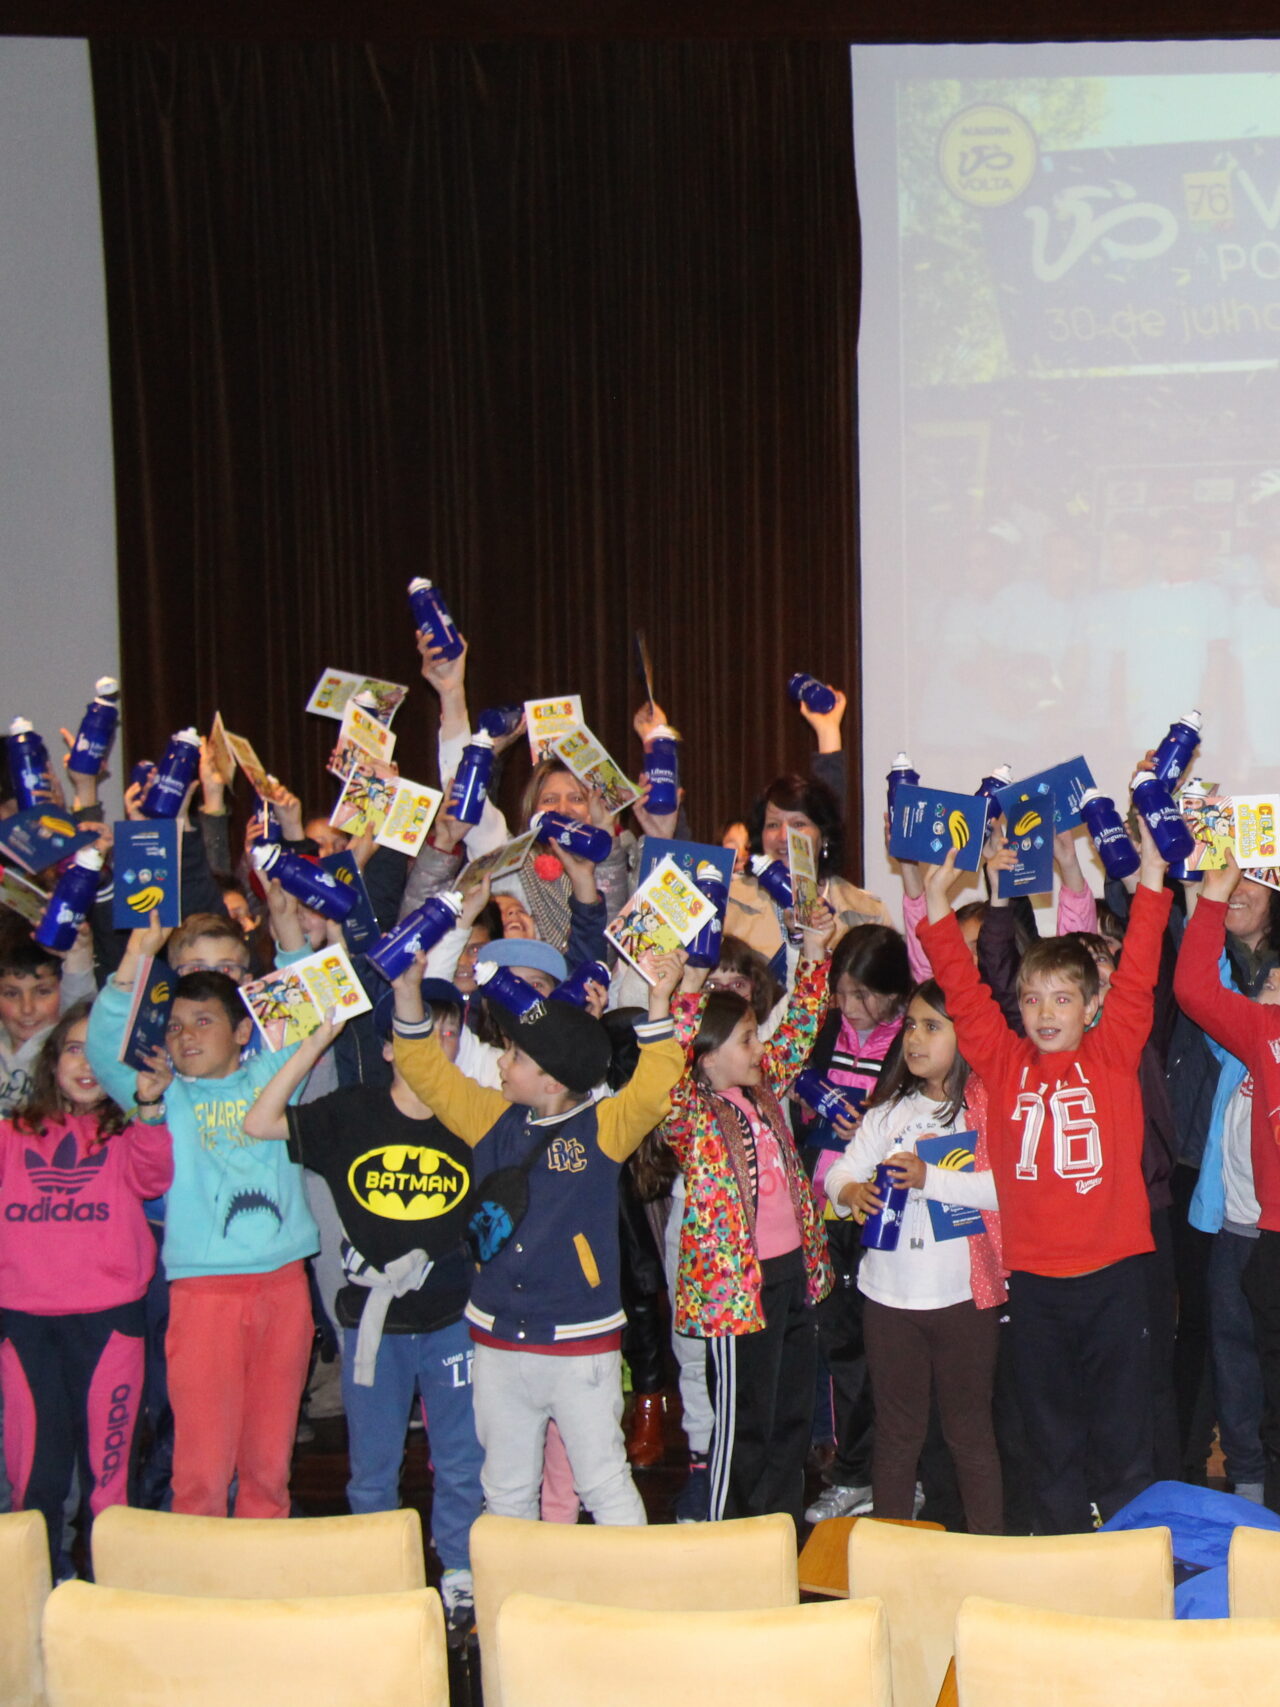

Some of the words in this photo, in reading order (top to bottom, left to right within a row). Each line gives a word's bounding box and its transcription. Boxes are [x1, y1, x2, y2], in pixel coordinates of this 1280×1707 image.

[1045, 305, 1095, 342] 30
[1160, 807, 1180, 815] Libe
[1258, 805, 1275, 855] CICLAS
[663, 870, 703, 917] CICLAS
[324, 957, 359, 1006] CICLAS
[194, 1099, 248, 1129] EWARE
[1011, 1087, 1104, 1181] 76
[365, 1170, 458, 1194] BATMAN
[5, 1197, 110, 1223] adidas
[101, 1383, 132, 1488] adidas
